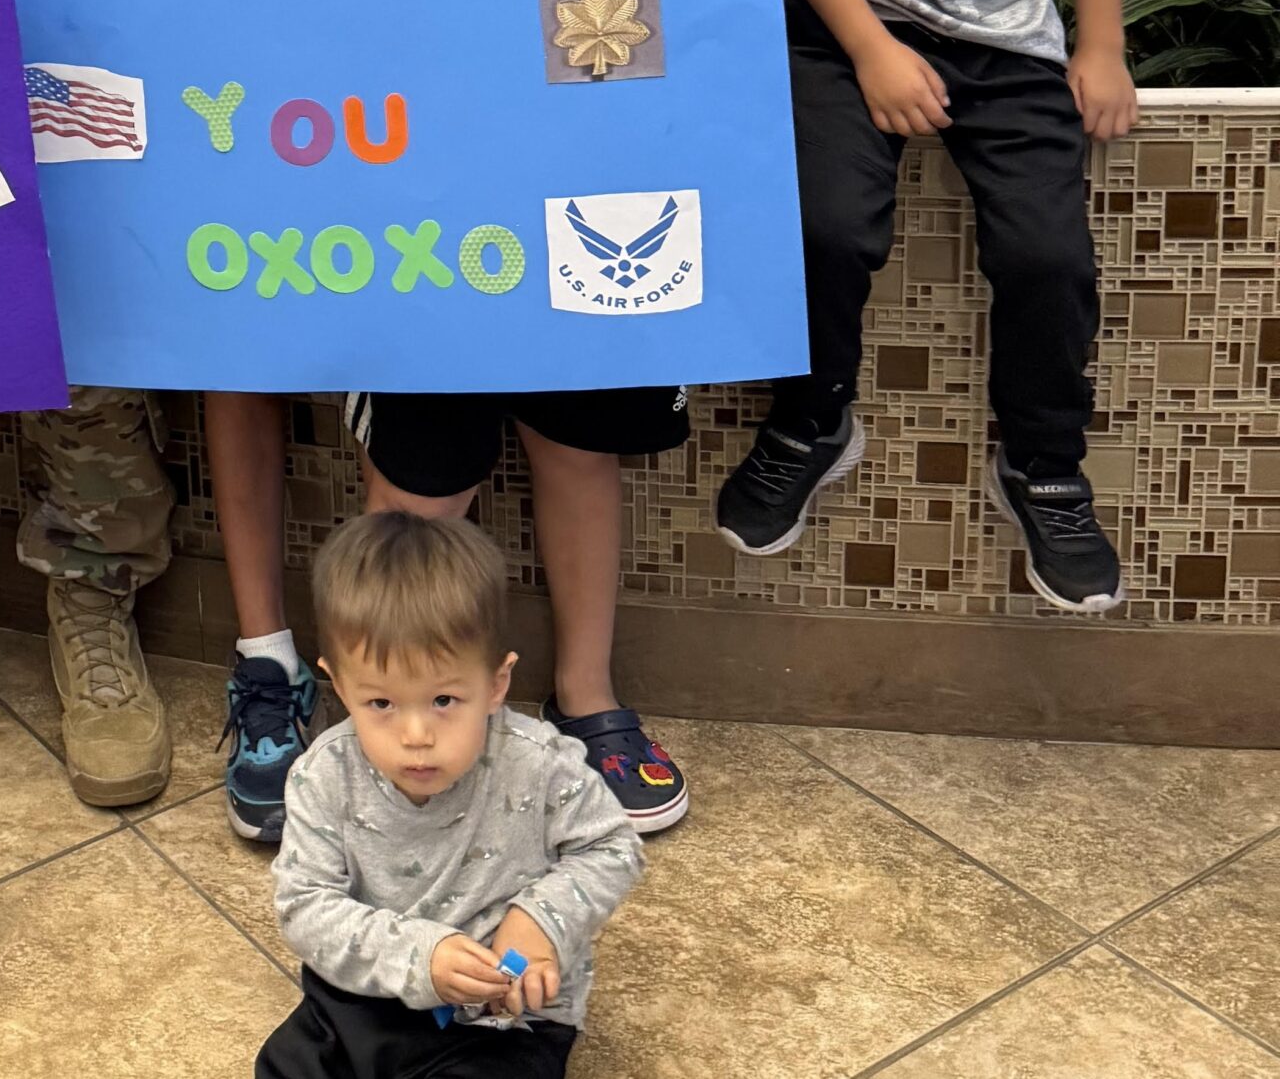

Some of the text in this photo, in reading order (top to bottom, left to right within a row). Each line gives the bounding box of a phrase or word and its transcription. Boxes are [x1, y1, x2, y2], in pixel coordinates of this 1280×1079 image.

[181, 80, 408, 167] YOU
[186, 219, 526, 299] OXOXO
[558, 259, 693, 309] U.S. AIR FORCE
